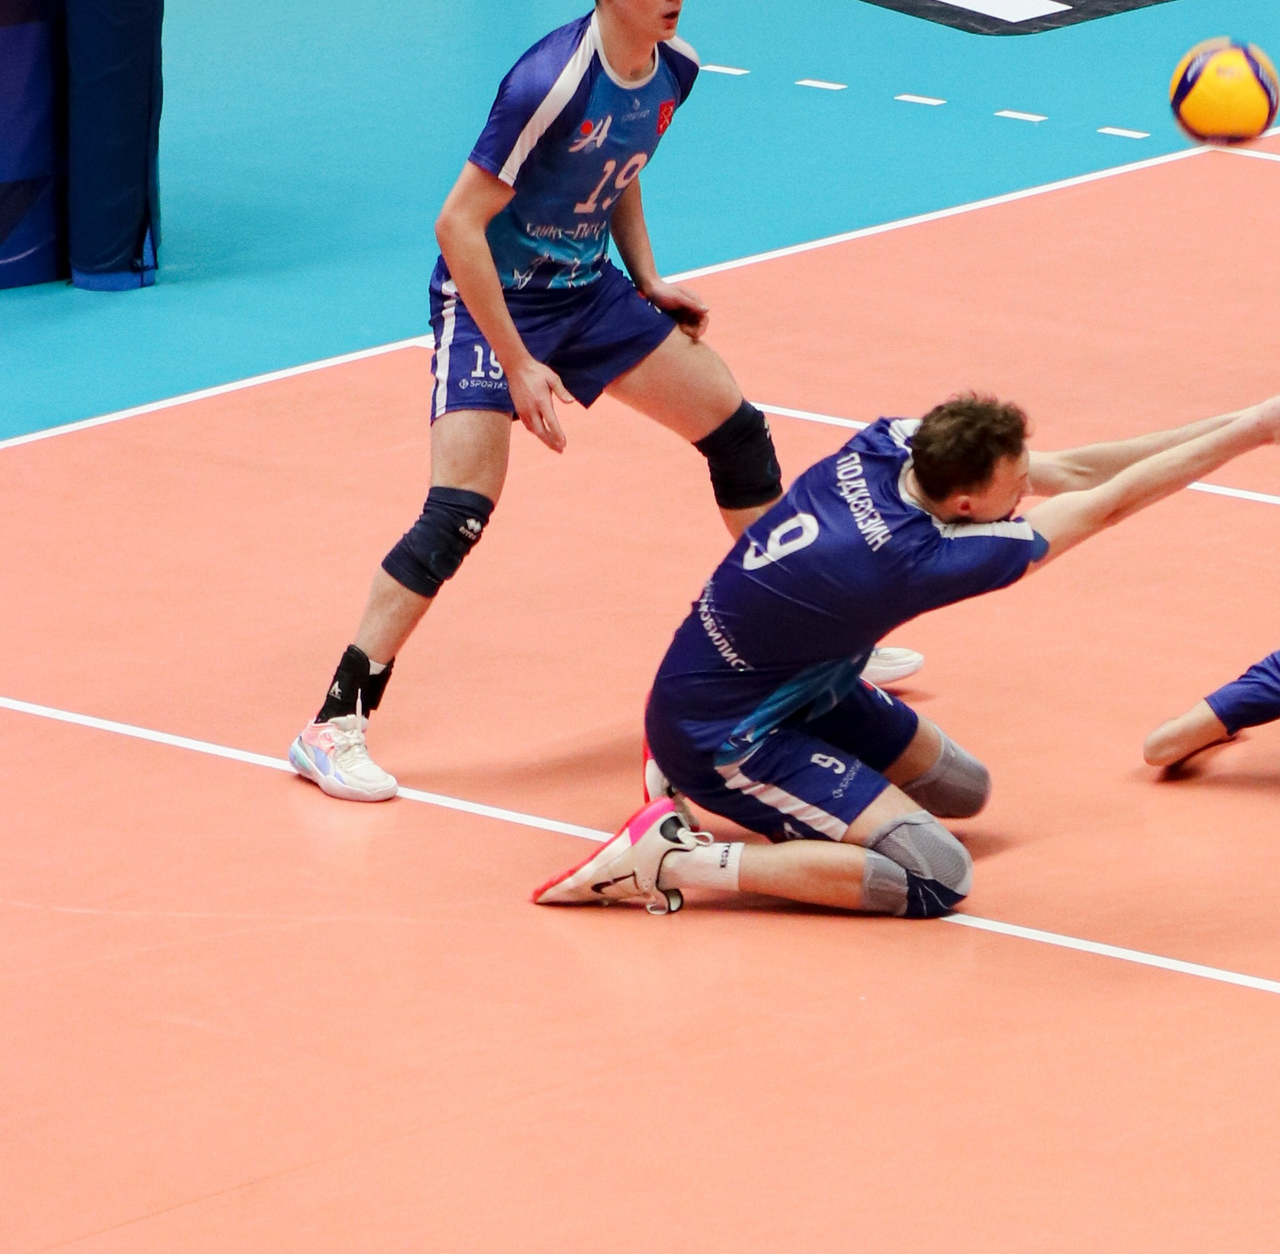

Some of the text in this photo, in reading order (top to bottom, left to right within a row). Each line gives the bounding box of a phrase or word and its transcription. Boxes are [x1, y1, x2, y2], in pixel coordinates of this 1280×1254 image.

[573, 151, 648, 214] 19
[742, 512, 819, 571] 9
[810, 752, 847, 776] 9
